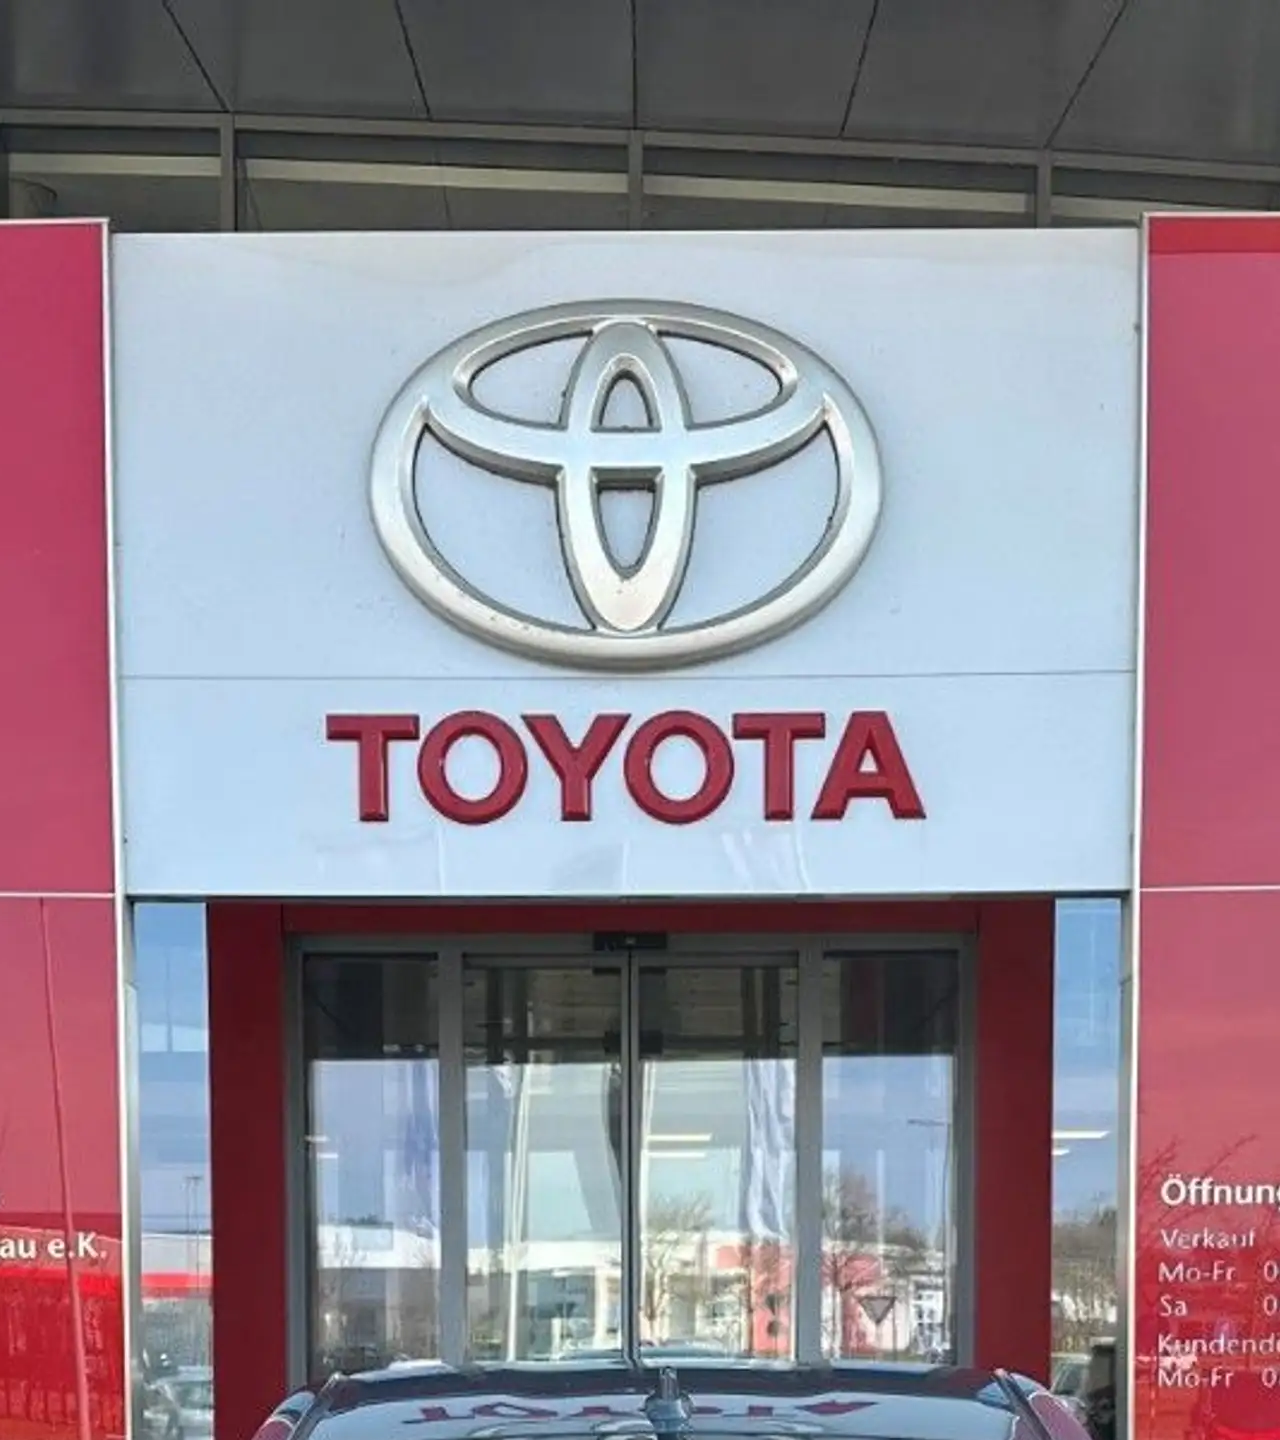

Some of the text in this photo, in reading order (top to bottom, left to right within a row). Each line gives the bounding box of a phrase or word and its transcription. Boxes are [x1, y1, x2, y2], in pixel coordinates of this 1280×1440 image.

[326, 710, 927, 825] TOYOTA
[47, 1232, 108, 1259] e.K.
[1161, 1228, 1256, 1248] Verkauf
[1158, 1263, 1236, 1282] Mo-Fr
[1160, 1297, 1188, 1317] Sa
[1158, 1367, 1235, 1388] Mo-Fr
